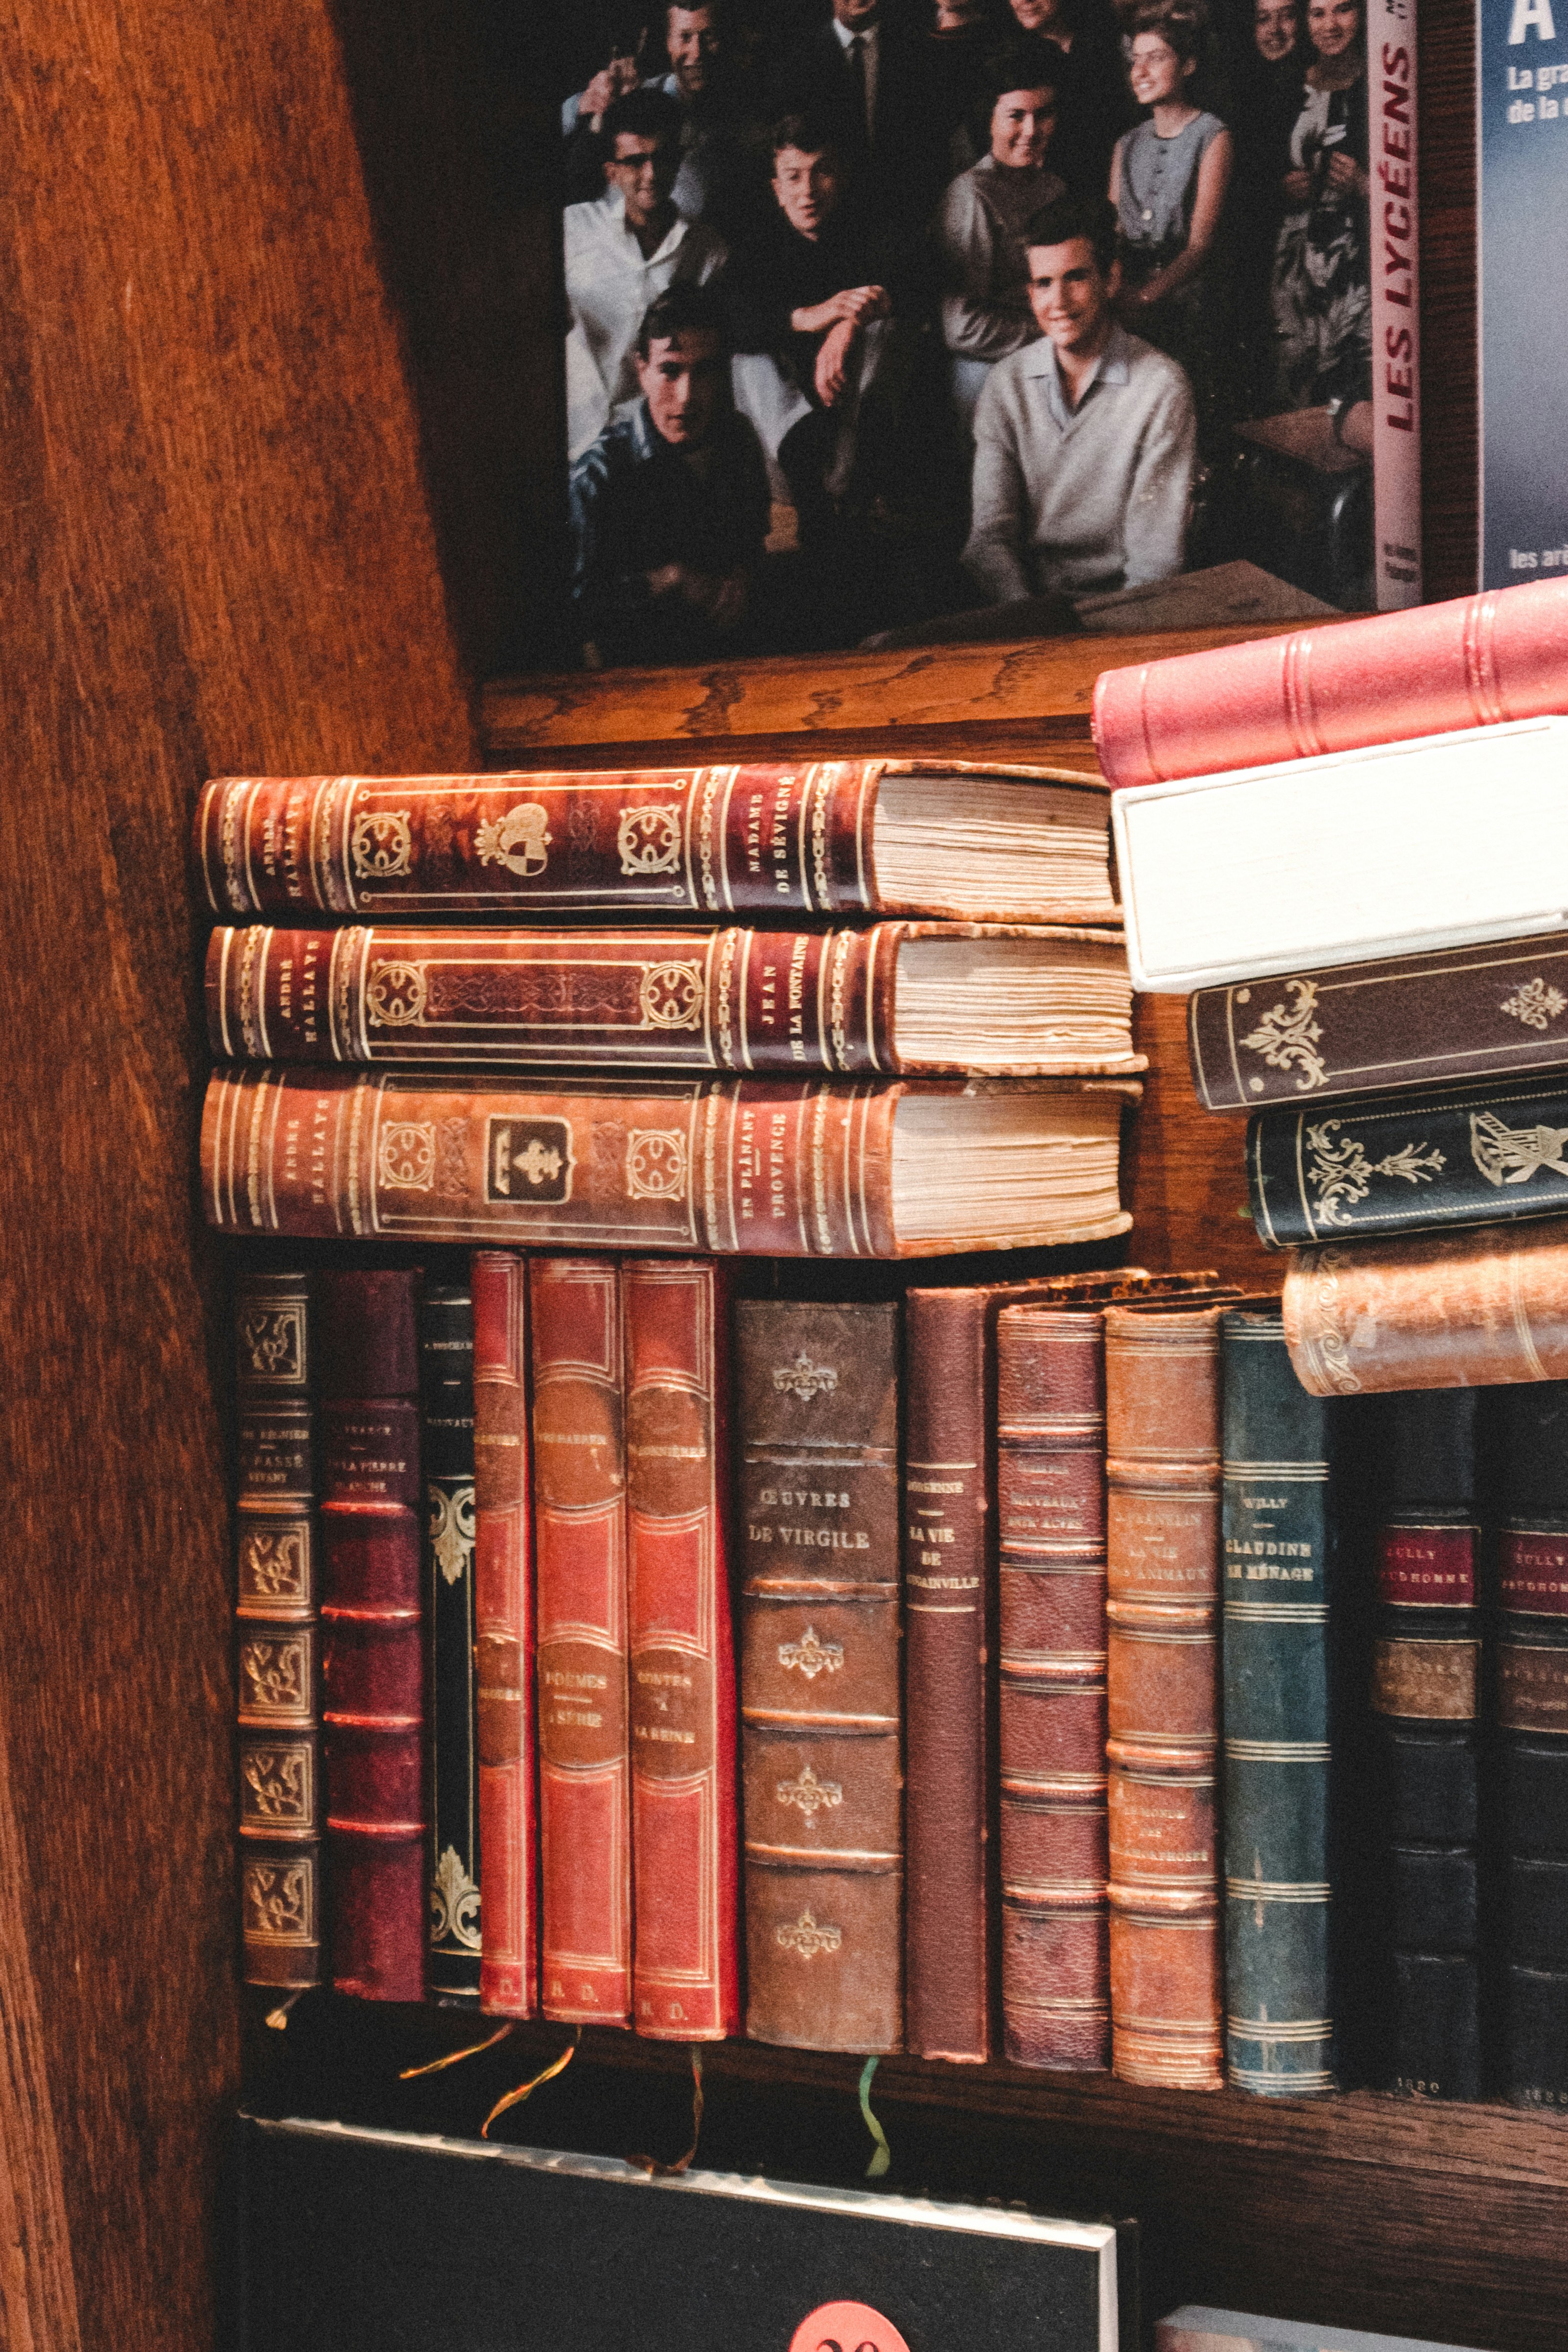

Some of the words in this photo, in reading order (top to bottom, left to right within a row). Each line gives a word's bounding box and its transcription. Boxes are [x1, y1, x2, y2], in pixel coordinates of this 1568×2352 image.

[1508, 67, 1533, 91] La
[1508, 99, 1535, 124] de
[1539, 95, 1559, 119] la
[1377, 42, 1412, 308] LYCÉENS
[1385, 326, 1413, 431] LES
[1509, 549, 1538, 569] les
[771, 776, 796, 860] SÉVIGNÉ
[284, 793, 303, 898] HALLAYS
[749, 794, 763, 872] MADAME
[775, 869, 790, 893] DE
[789, 935, 810, 1009] FONTAINE
[280, 958, 293, 1019] ANDRÉ
[304, 940, 320, 1043] HALLAYS
[761, 965, 776, 1025] JEAN
[789, 1014, 802, 1034] LA
[789, 1040, 807, 1061] DE
[312, 1099, 329, 1204] HALLAYS
[771, 1113, 786, 1218] PROVENCE
[741, 1197, 754, 1219] EN
[1242, 1498, 1289, 1510] WILLY
[749, 1525, 772, 1543] DE
[779, 1527, 870, 1549] VIRGILE
[909, 1526, 925, 1542] LA
[927, 1528, 956, 1543] VIE
[921, 1552, 942, 1566] DE
[1225, 1539, 1312, 1558] CLAUDINE
[1246, 1563, 1314, 1582] MÉNAGE
